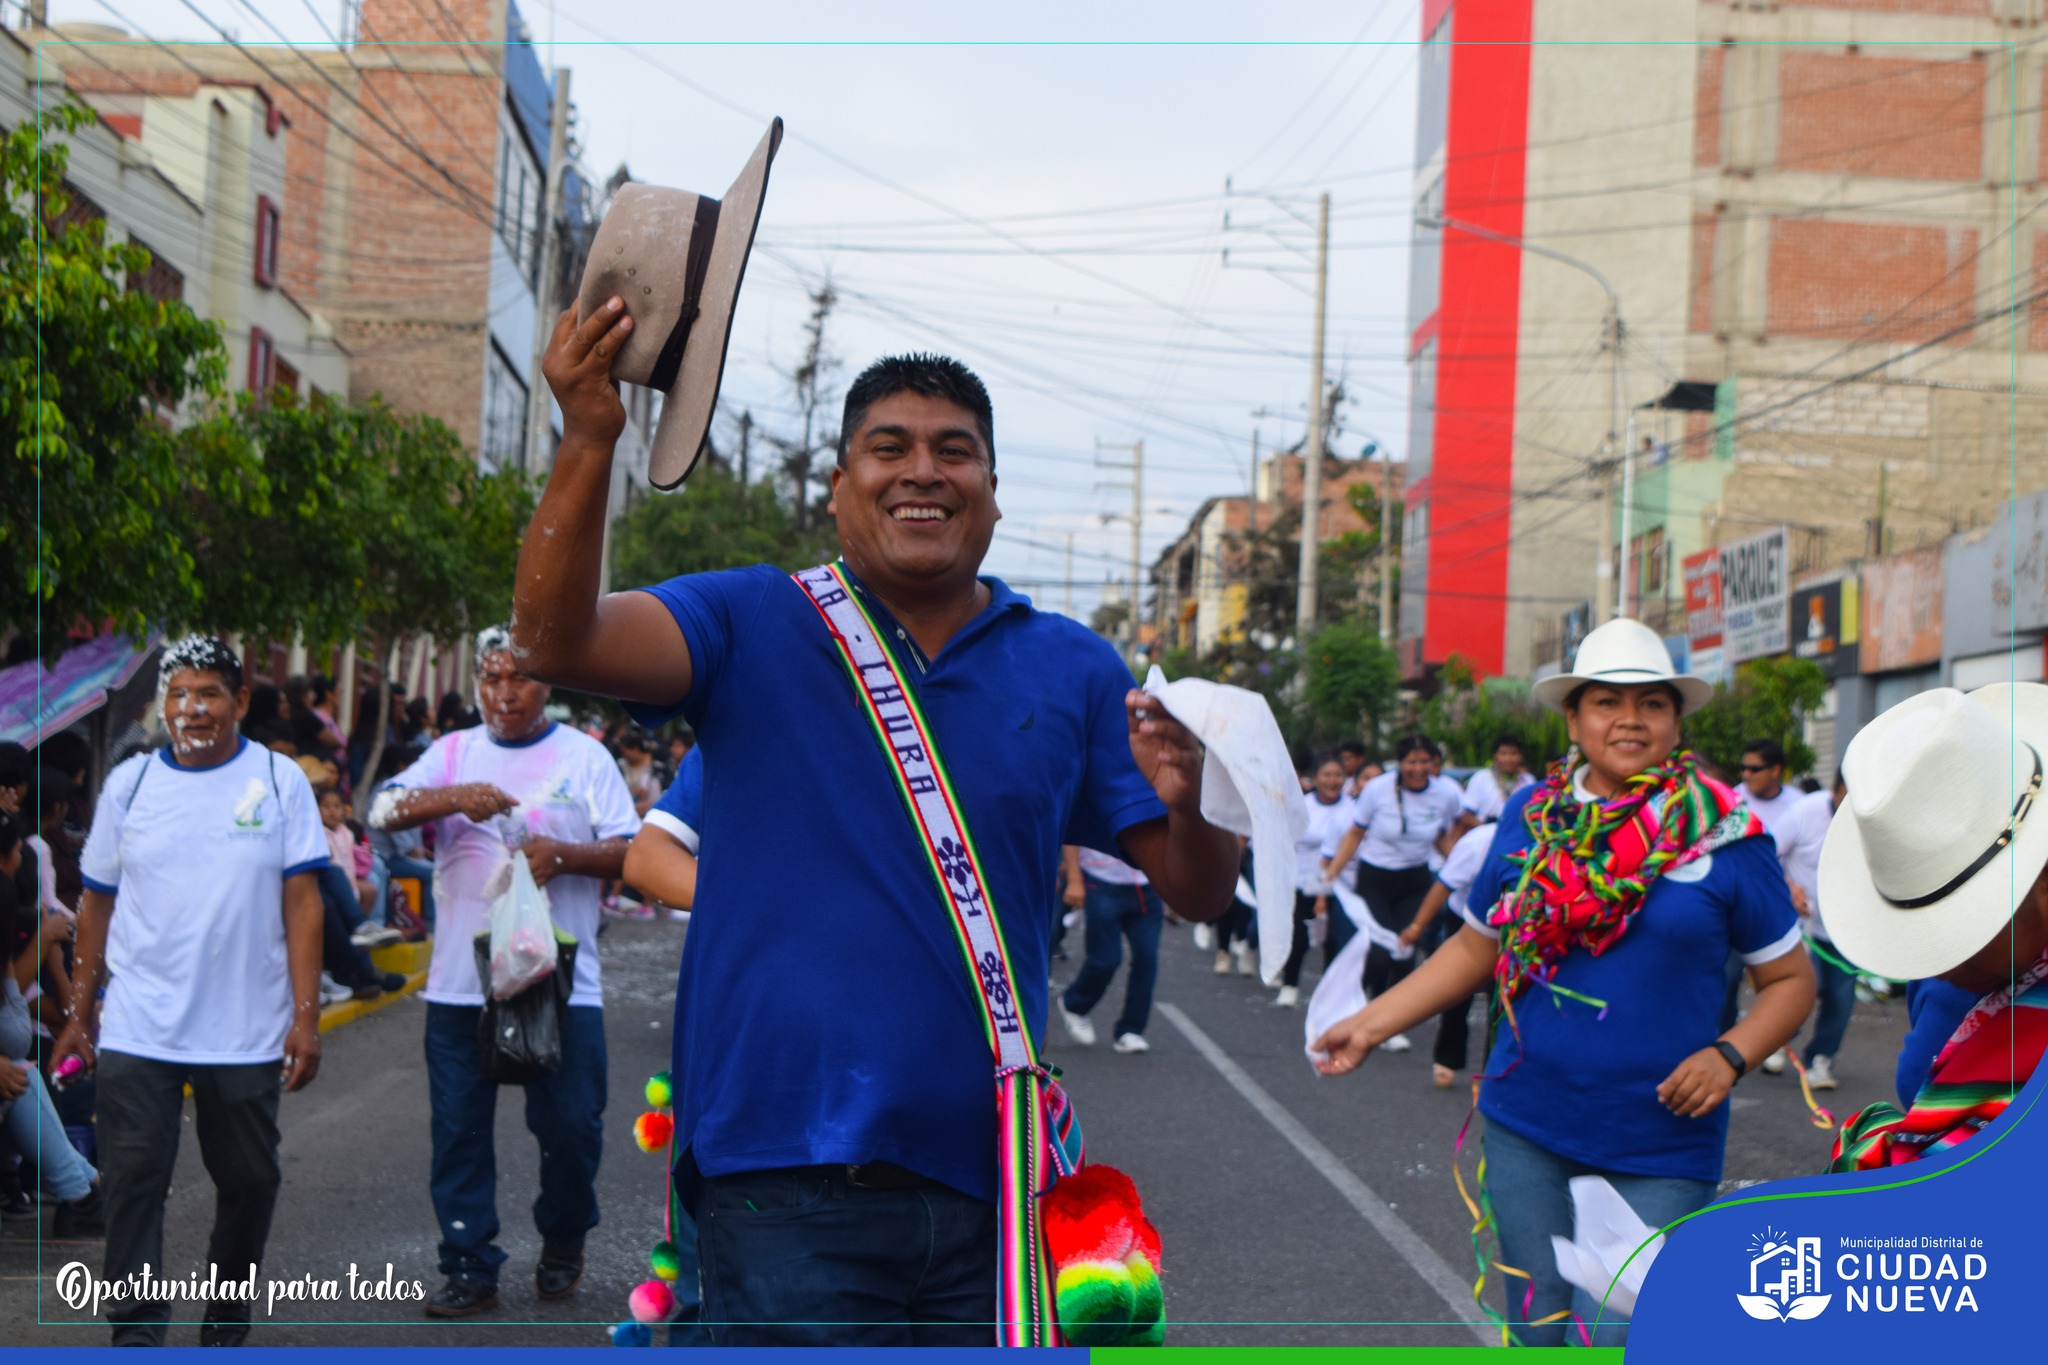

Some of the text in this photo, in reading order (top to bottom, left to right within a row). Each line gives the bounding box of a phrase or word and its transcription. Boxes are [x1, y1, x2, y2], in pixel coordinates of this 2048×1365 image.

[1721, 533, 1783, 606] PARQUET
[796, 565, 848, 609] ZA
[860, 661, 937, 794] CHURA
